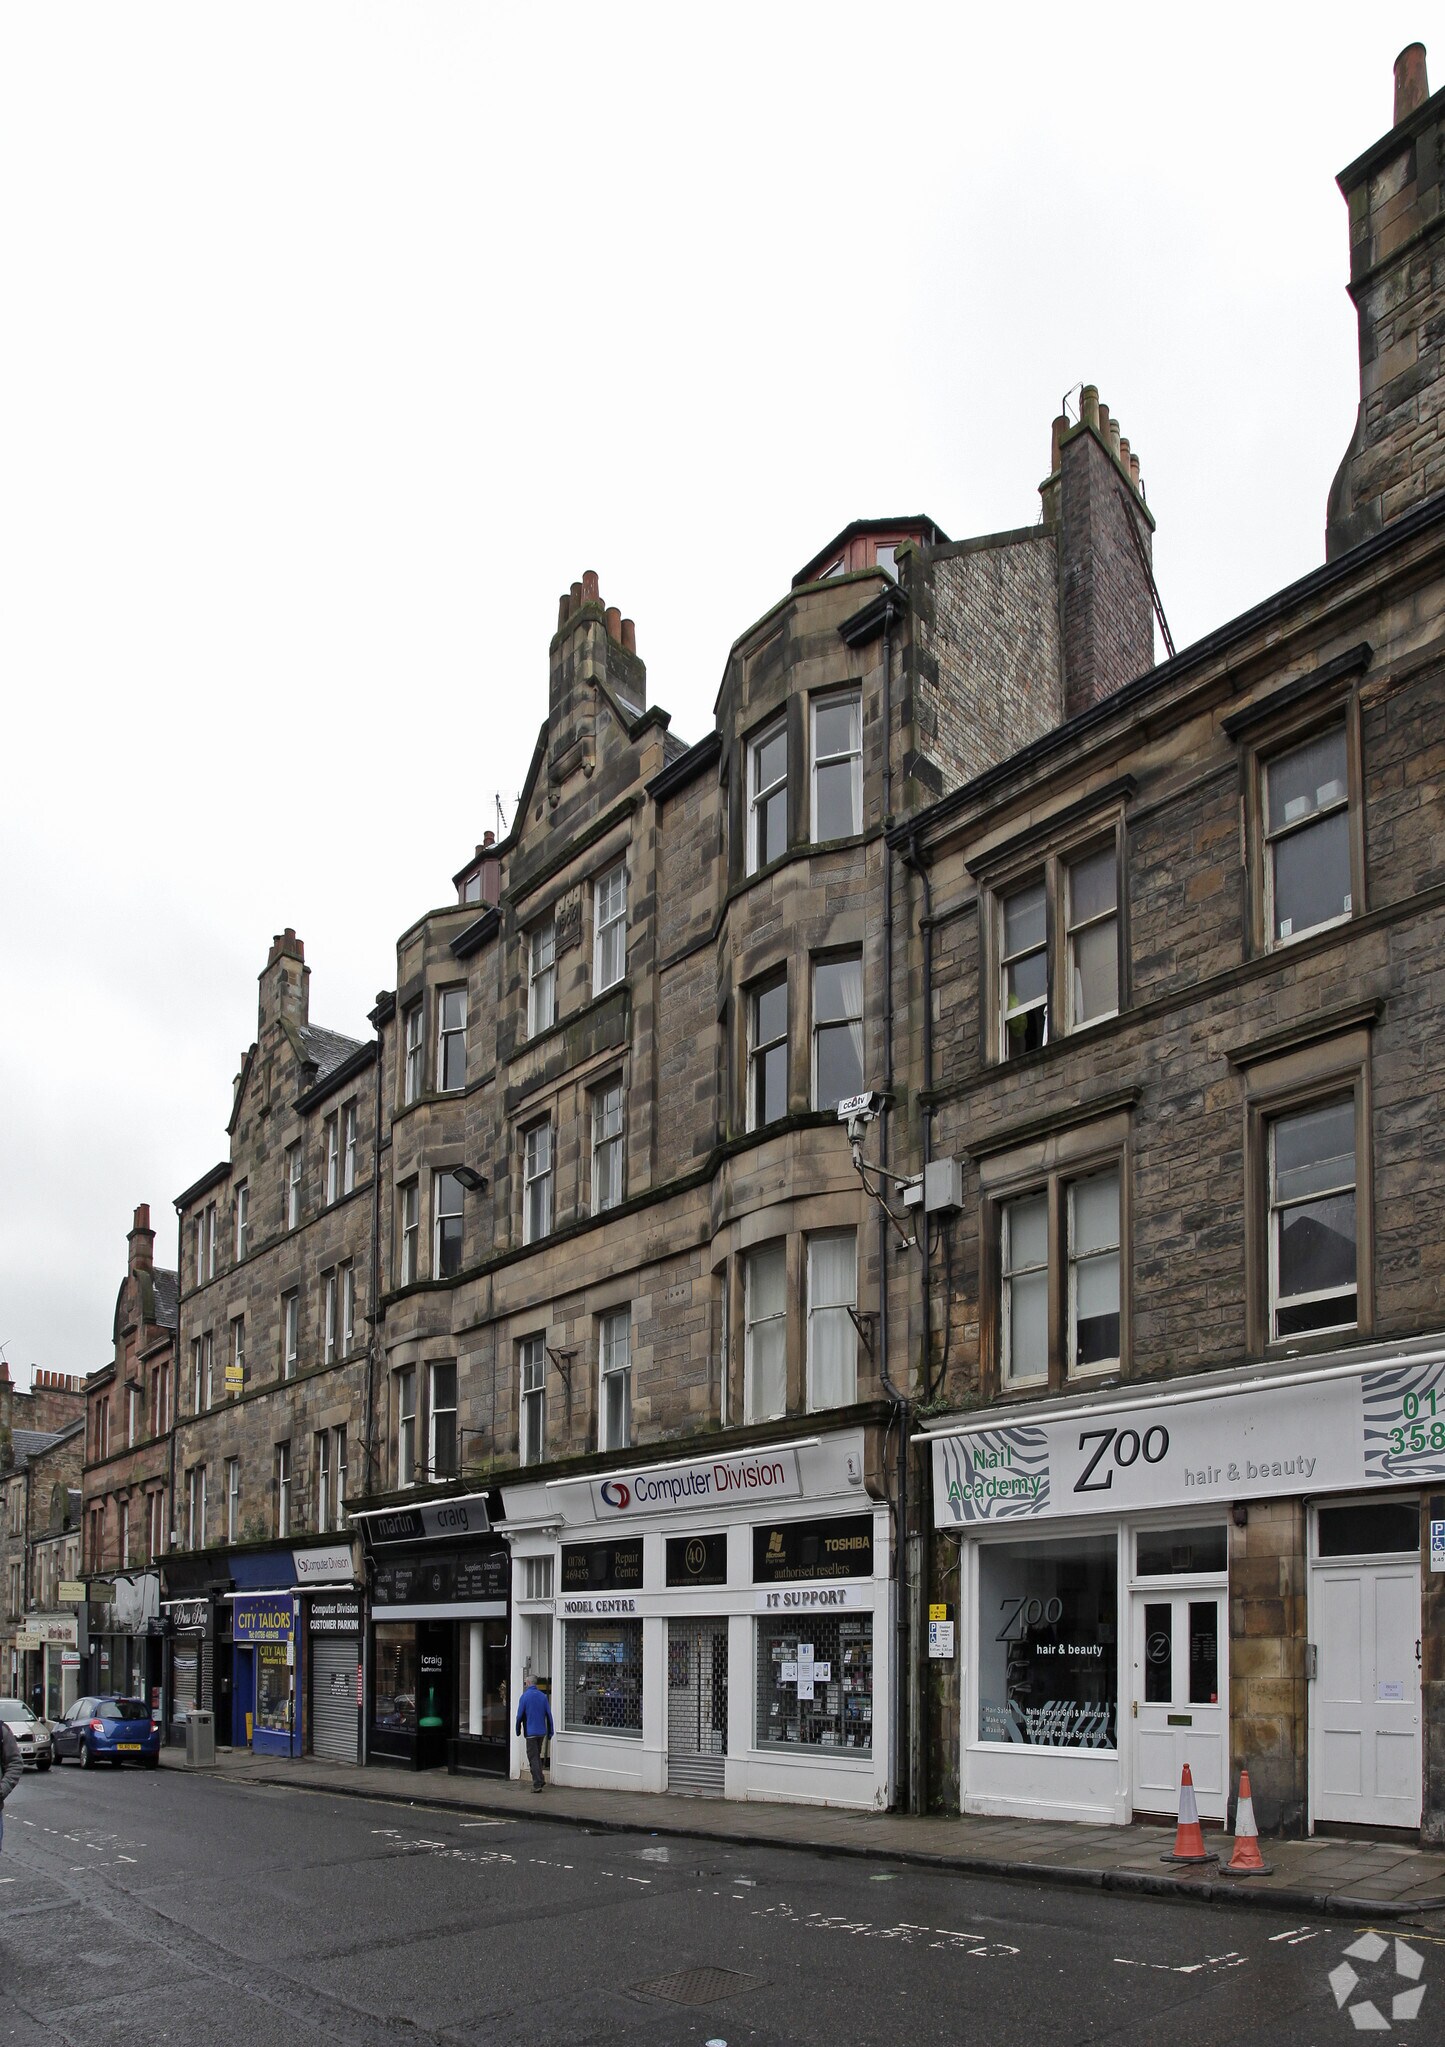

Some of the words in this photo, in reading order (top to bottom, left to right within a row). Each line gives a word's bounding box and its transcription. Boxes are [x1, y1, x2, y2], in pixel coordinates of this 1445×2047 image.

[973, 1446, 1013, 1470] Nail
[1184, 1466, 1222, 1487] hair
[1227, 1464, 1241, 1481] &
[1246, 1456, 1317, 1480] beauty
[634, 1471, 711, 1503] Computer
[714, 1460, 785, 1492] Division
[948, 1472, 1041, 1502] Academy
[437, 1501, 469, 1531] craig
[378, 1511, 415, 1535] martin
[825, 1536, 870, 1552] TOSHIBA
[567, 1555, 586, 1567] 01786
[615, 1551, 639, 1567] Repair
[688, 1547, 701, 1563] 40
[306, 1559, 328, 1572] Computer
[328, 1557, 349, 1569] Division
[774, 1565, 815, 1579] authorised
[816, 1563, 850, 1576] resellers
[395, 1570, 413, 1578] Bathroom
[566, 1568, 589, 1580] 469455
[614, 1566, 639, 1578] Centre
[395, 1581, 407, 1590] Design
[395, 1591, 407, 1599] Studio
[766, 1593, 780, 1607] IT
[783, 1589, 847, 1607] SUPPORT
[311, 1604, 336, 1616] Computer
[336, 1603, 359, 1614] Division
[564, 1600, 593, 1613] MODEL
[596, 1599, 636, 1612] CENTRE
[238, 1613, 257, 1629] CITY
[259, 1612, 291, 1629] TAILORS
[310, 1620, 336, 1629] CUSTOMER
[995, 1596, 1063, 1641] Zoo
[260, 1646, 272, 1657] CITY
[1037, 1644, 1055, 1655] hair
[1058, 1644, 1066, 1655] &
[1068, 1644, 1103, 1657] beauty
[1152, 1639, 1166, 1657] Z
[996, 1706, 1012, 1714] Salon
[1075, 1709, 1079, 1717] &
[1080, 1710, 1110, 1718] Manicures
[985, 1716, 999, 1724] Make
[1026, 1718, 1041, 1727] Spray
[1043, 1719, 1065, 1728] Tanning
[985, 1726, 1005, 1735] Waxing
[1026, 1728, 1050, 1739] Wedding
[1051, 1730, 1074, 1739] Package
[1076, 1731, 1107, 1741] Specialists
